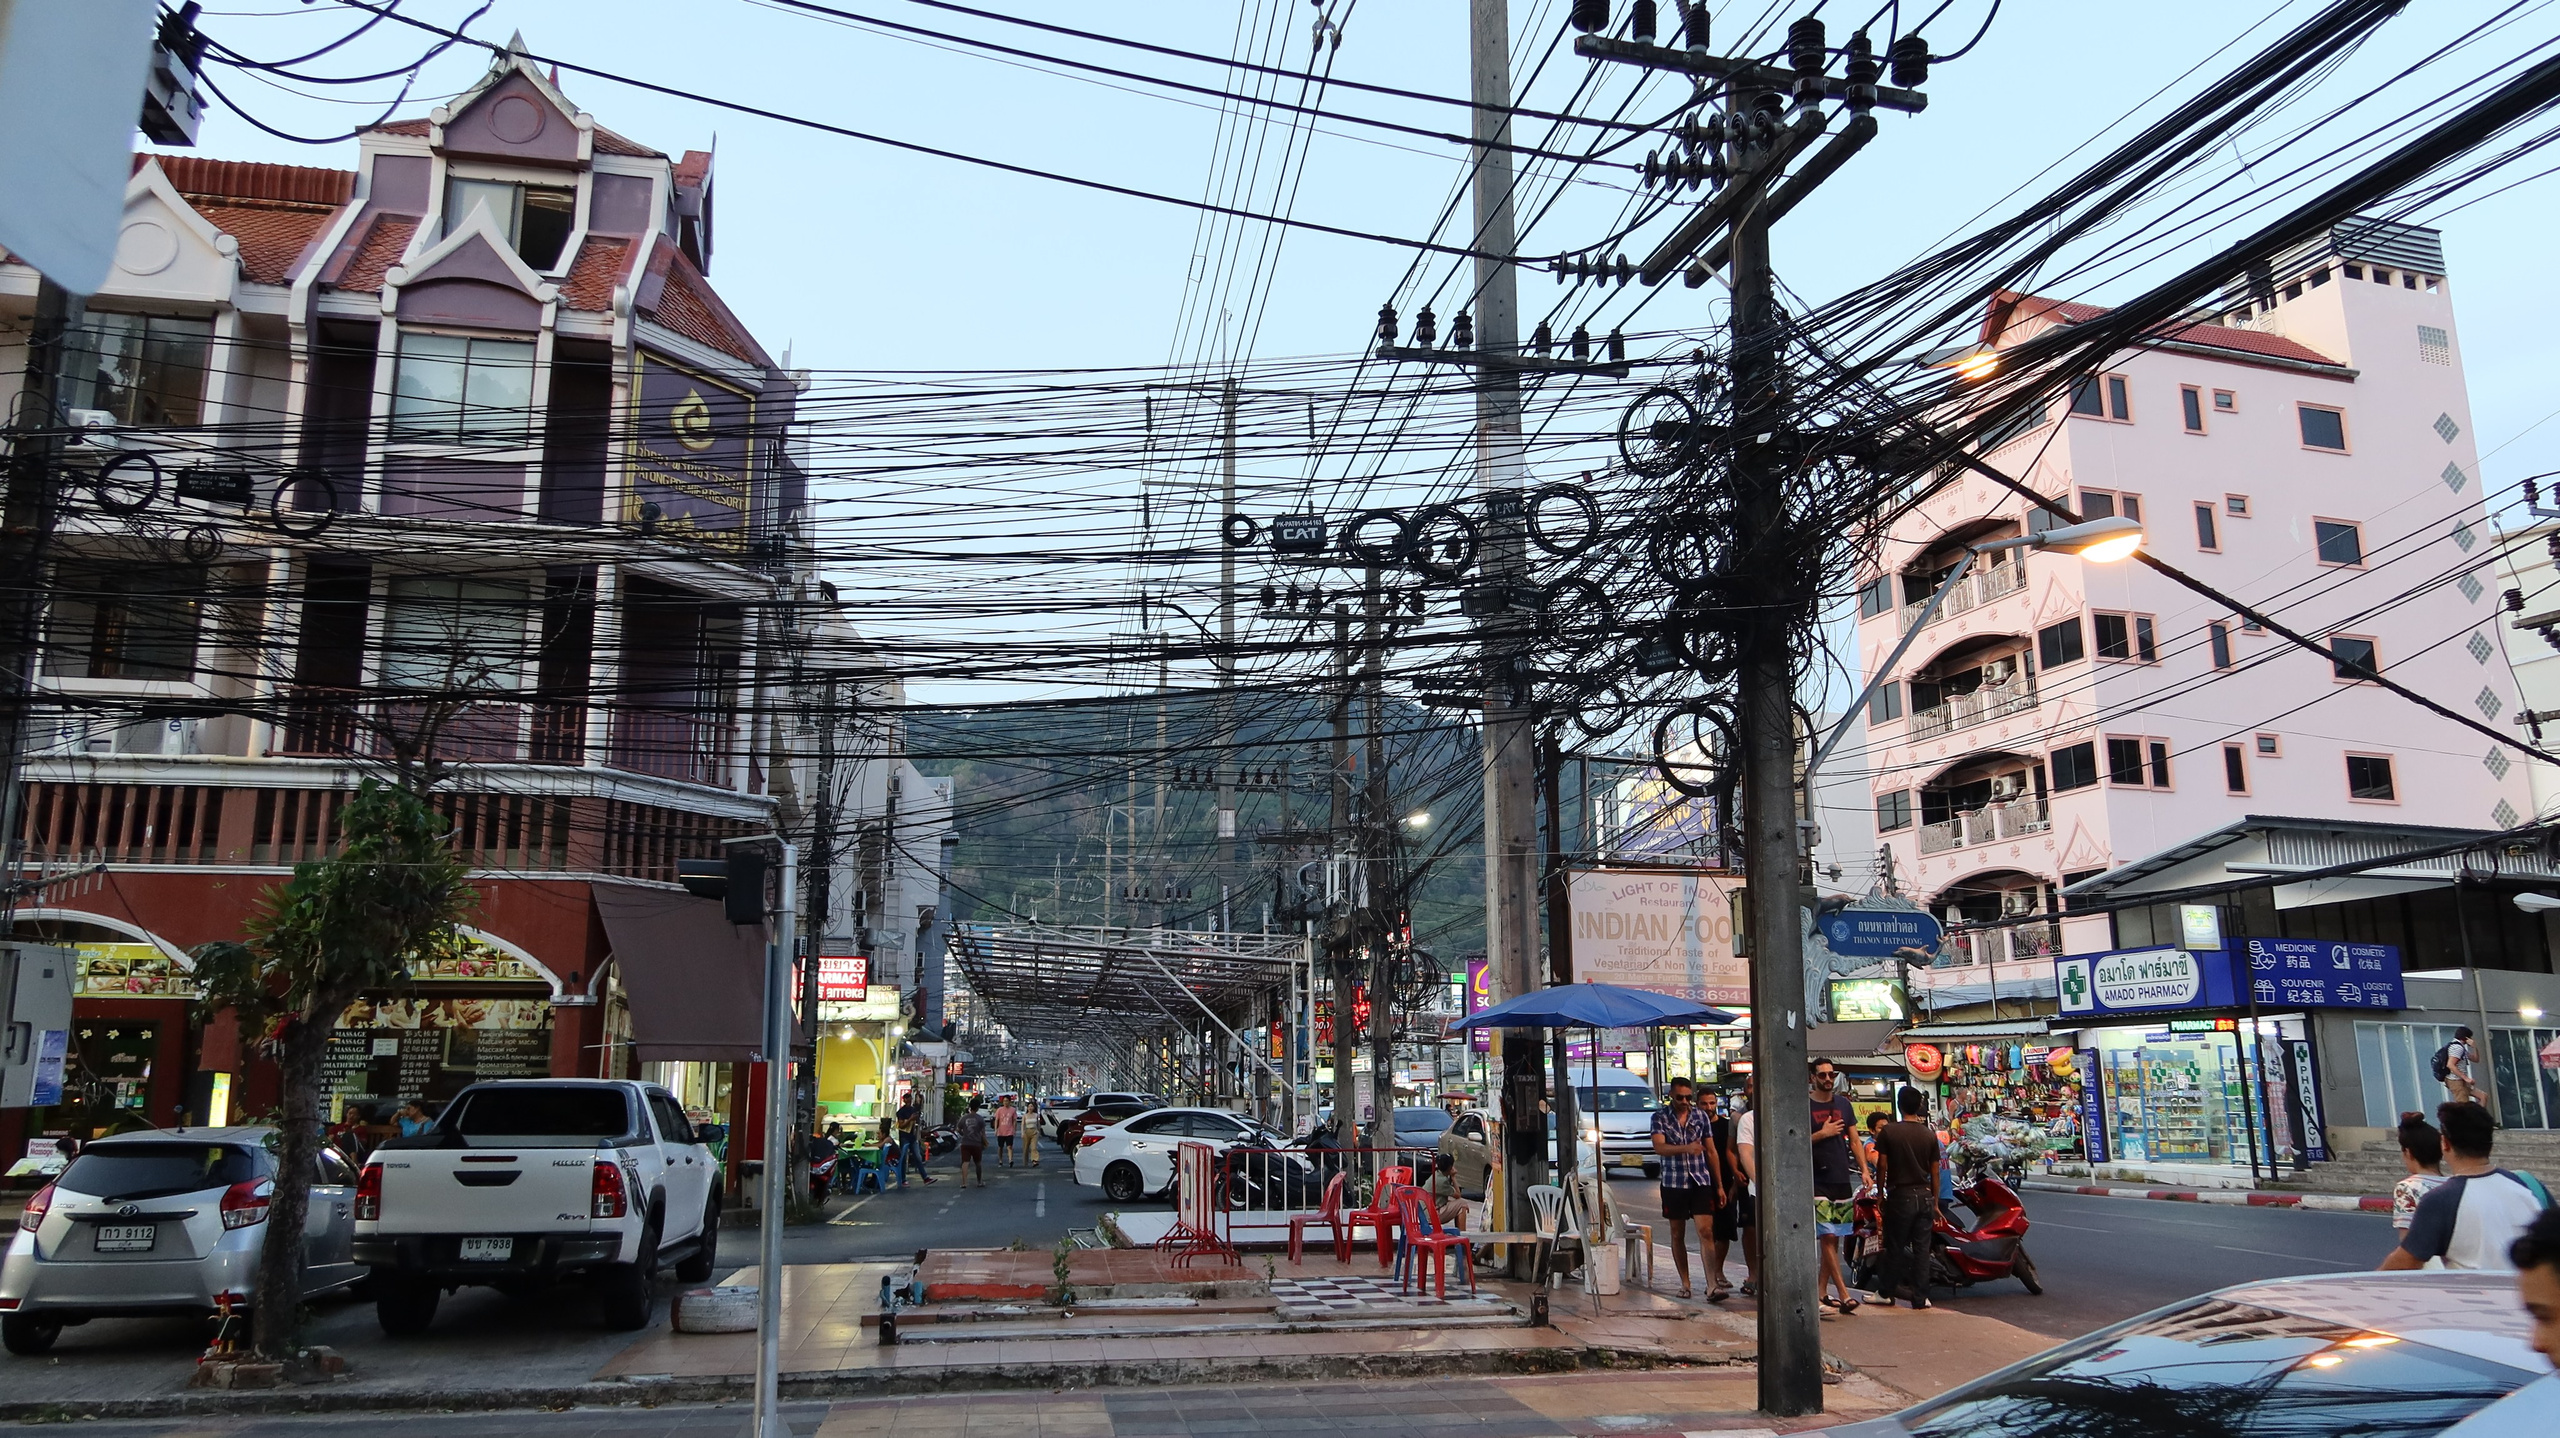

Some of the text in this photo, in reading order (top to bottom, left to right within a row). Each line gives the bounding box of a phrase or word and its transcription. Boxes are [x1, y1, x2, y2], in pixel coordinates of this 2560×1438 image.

[1283, 527, 1318, 540] CAT
[1612, 882, 1721, 907] LIGHT OF INDIA
[1640, 897, 1696, 908] Restaurant
[1578, 911, 1732, 944] INDIAN FOO
[1858, 914, 1918, 933] ถนนหาดป่าตอง
[1853, 936, 1923, 946] THANON HATPATONG
[1617, 946, 1719, 957] Traditional Taste of
[2275, 943, 2317, 953] MEDICINE
[2351, 947, 2385, 957] COSMETIC
[1594, 958, 1738, 973] Vegetarian & Non Veg Food
[2286, 955, 2311, 969] 药品
[2358, 959, 2382, 971] 化妆品
[2098, 954, 2188, 983] อมาโด ฟาร์มาซี
[1659, 974, 1690, 983] Further
[1691, 975, 1718, 984] Down
[2281, 978, 2325, 988] SOUVENIR
[2105, 983, 2190, 1002] AMADO PHARMACY
[2362, 982, 2393, 992] LOGISTIC
[2287, 989, 2325, 1004] 纪念品
[2171, 1019, 2216, 1031] PHARMACY
[2300, 1066, 2316, 1146] PHARMACY
[126, 1227, 153, 1239] 9112
[487, 1239, 511, 1250] 7938
